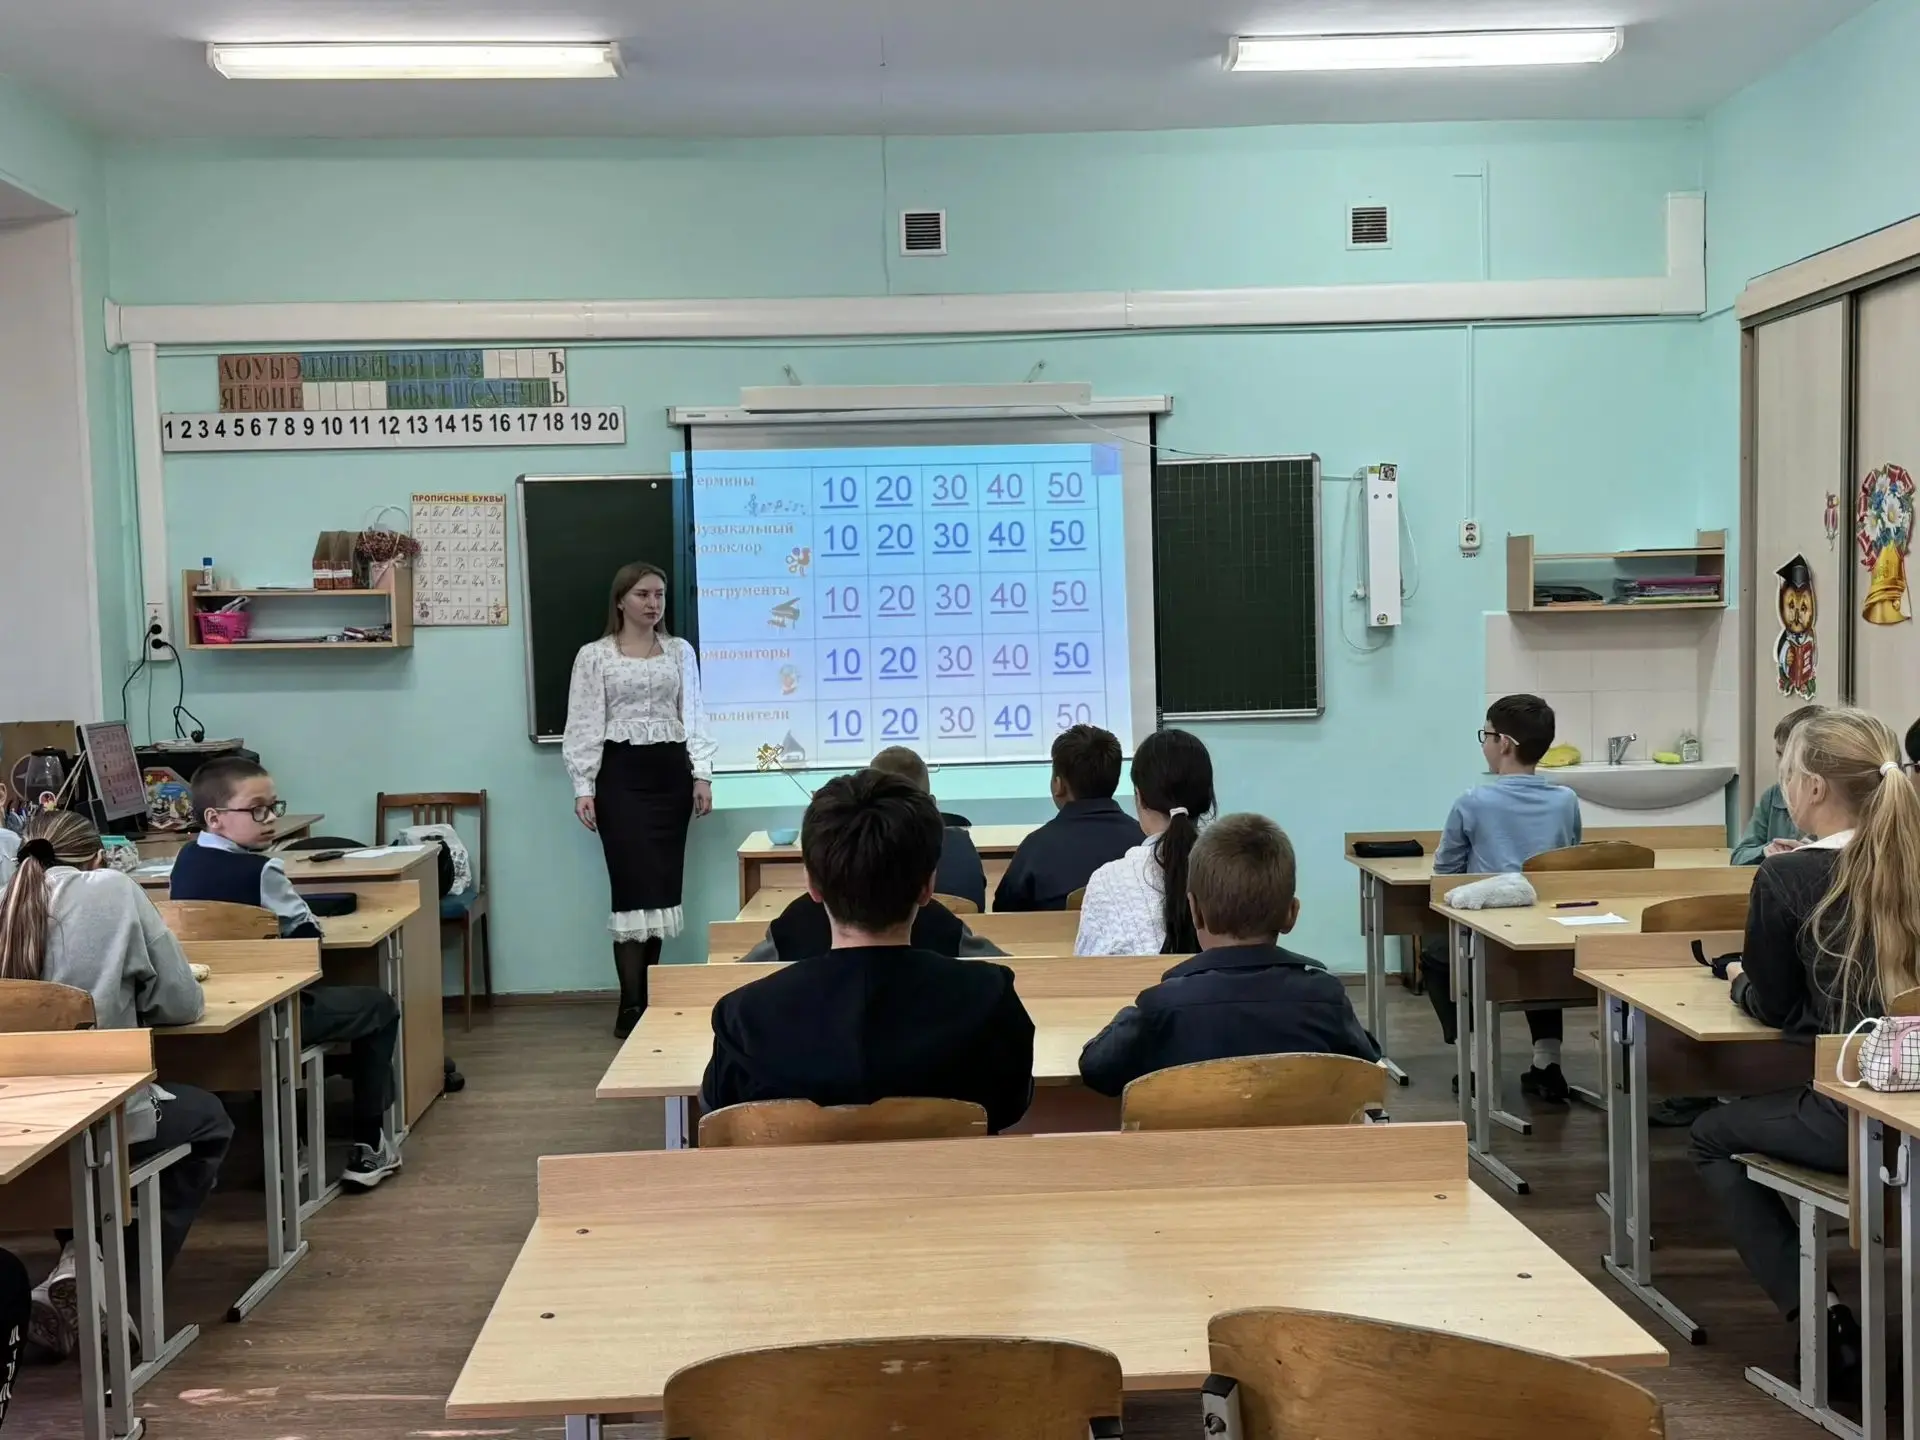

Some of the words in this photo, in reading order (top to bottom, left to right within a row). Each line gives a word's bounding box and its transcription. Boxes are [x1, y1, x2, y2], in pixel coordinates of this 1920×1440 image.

[165, 421, 172, 438] 1
[181, 421, 191, 438] 2
[199, 420, 208, 438] 3
[215, 420, 226, 437] 4
[234, 419, 244, 436] 5
[251, 418, 261, 436] 6
[268, 418, 278, 435] 7
[285, 418, 295, 435] 8
[304, 418, 314, 435] 9
[322, 417, 342, 435] 10
[350, 416, 369, 434] 11
[379, 417, 400, 434] 12
[407, 416, 427, 433] 13
[435, 415, 456, 432] 14
[461, 414, 482, 432] 15
[490, 414, 510, 432] 16
[518, 414, 537, 431] 17
[543, 413, 564, 431] 18
[571, 413, 591, 430] 19
[598, 413, 618, 430] 20
[695, 476, 754, 488] ермины
[823, 477, 857, 503] 10
[876, 476, 911, 501] 20
[933, 475, 967, 500] 30
[986, 474, 1022, 499] 40
[1048, 472, 1082, 498] 50
[696, 543, 761, 555] ольклор
[824, 525, 858, 551] 10
[878, 523, 913, 550] 20
[934, 522, 968, 548] 30
[988, 521, 1024, 547] 40
[1049, 520, 1084, 546] 50
[699, 586, 790, 598] нструменты
[826, 586, 860, 613] 10
[880, 584, 915, 611] 20
[936, 583, 971, 609] 30
[990, 582, 1026, 608] 40
[1052, 580, 1087, 606] 50
[700, 648, 790, 660] омпозиторы
[827, 648, 860, 675] 10
[880, 647, 916, 673] 20
[938, 645, 972, 672] 30
[993, 644, 1028, 670] 40
[1054, 642, 1089, 669] 50
[828, 710, 861, 736] 10
[882, 708, 918, 734] 20
[940, 706, 974, 732] 30
[994, 704, 1030, 731] 40
[1057, 703, 1091, 729] 50
